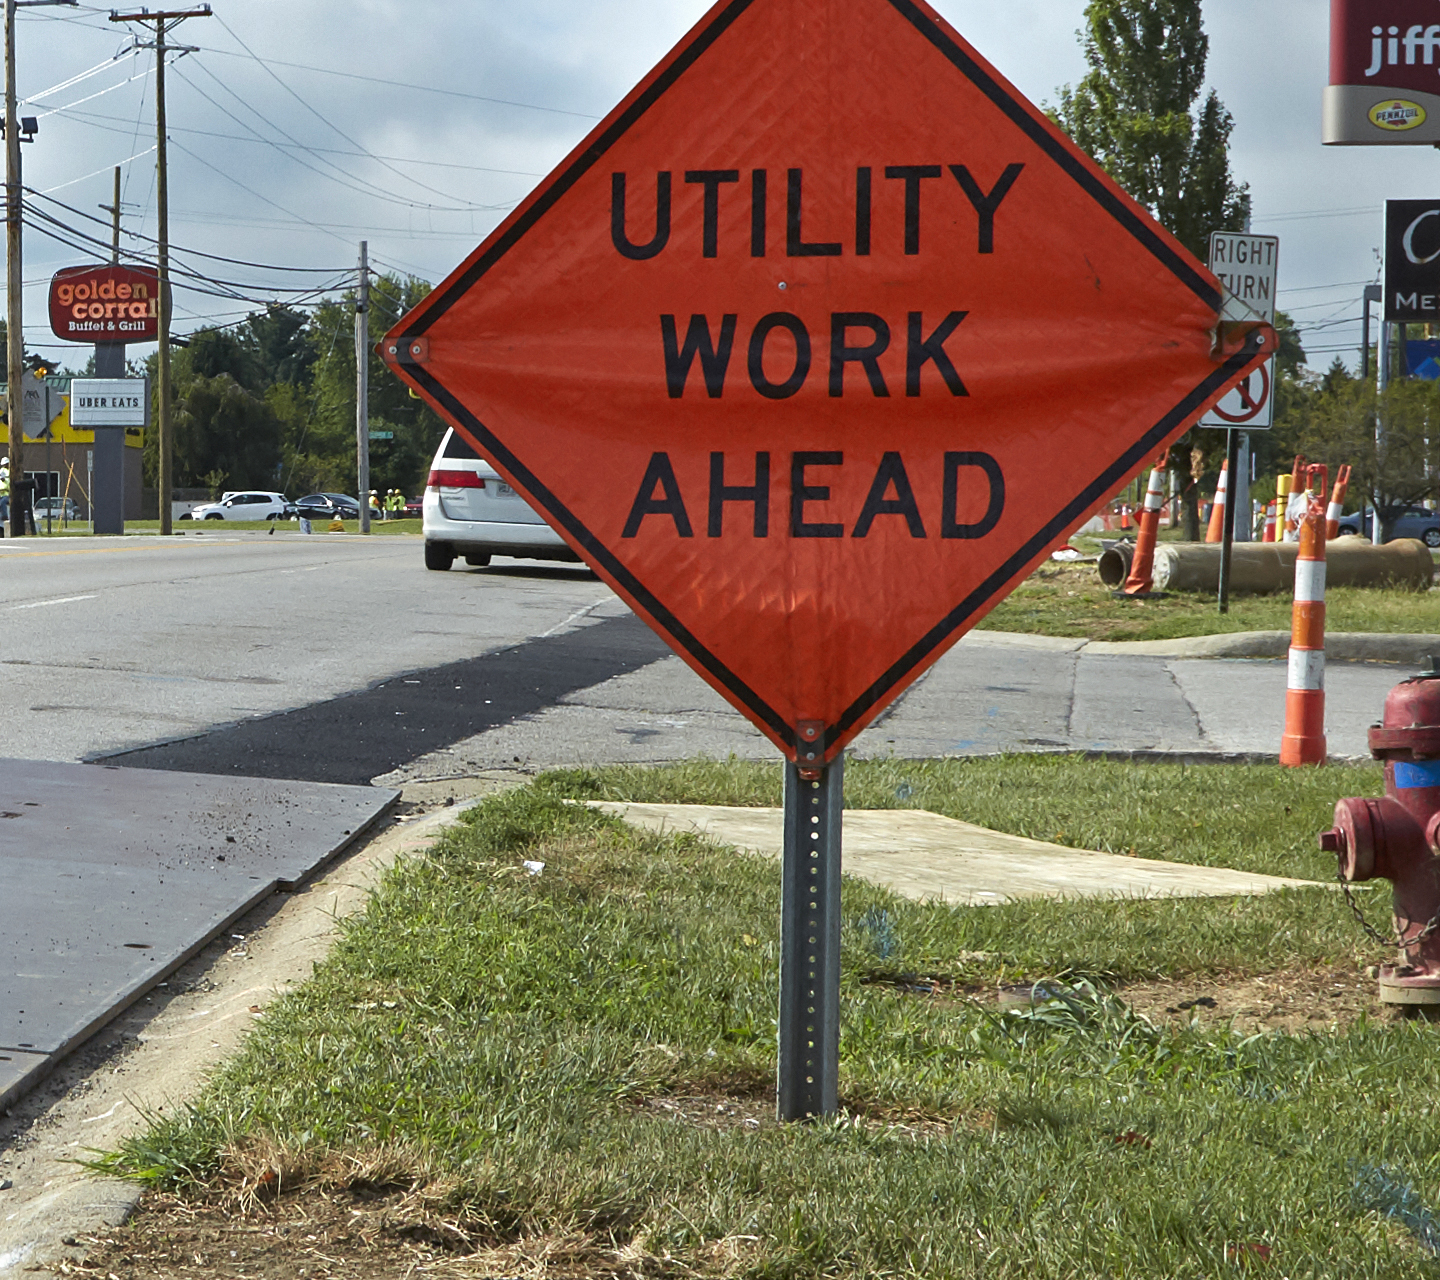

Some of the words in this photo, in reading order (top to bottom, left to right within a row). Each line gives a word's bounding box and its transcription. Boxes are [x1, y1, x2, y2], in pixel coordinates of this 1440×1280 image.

[1376, 108, 1419, 121] PENNZOIL
[610, 162, 1026, 261] UTILITY
[1215, 238, 1275, 265] RIGHT
[57, 280, 148, 306] golden
[72, 297, 157, 319] corral
[68, 321, 105, 331] Buffet
[107, 322, 115, 331] &
[119, 321, 146, 331] Grill
[660, 310, 970, 400] WORK
[79, 398, 107, 407] UBER
[112, 398, 139, 407] EATS
[621, 450, 1006, 540] AHEAD
